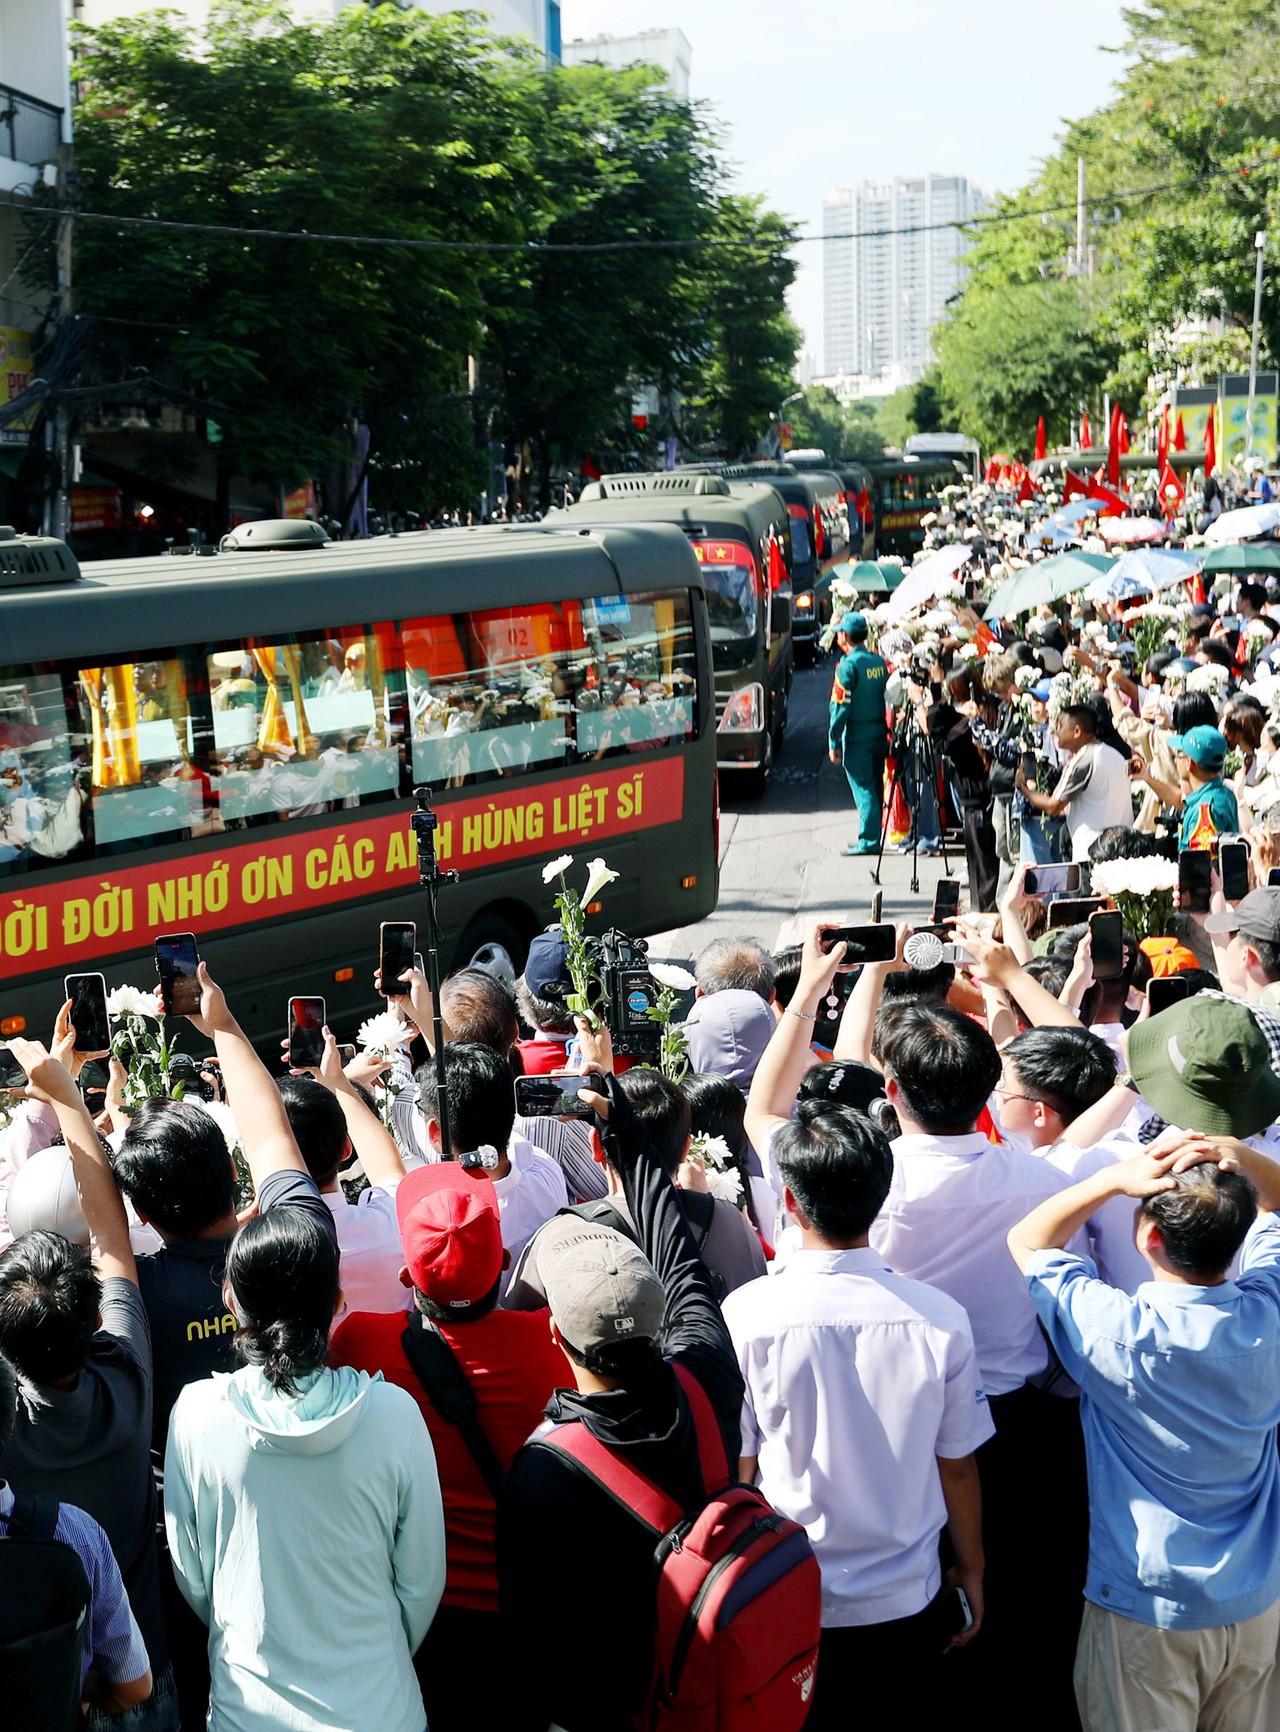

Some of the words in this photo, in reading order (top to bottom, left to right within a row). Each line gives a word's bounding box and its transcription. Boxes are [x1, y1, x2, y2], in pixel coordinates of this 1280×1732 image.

[867, 666, 884, 679] DQTT
[62, 881, 134, 945] ĐỜI
[148, 860, 229, 927] NHỚ
[241, 854, 294, 905] ƠN
[304, 833, 376, 891] CÁC
[462, 802, 544, 855] HÙNG
[553, 784, 609, 836] LIỆT
[616, 772, 645, 820] SĨ
